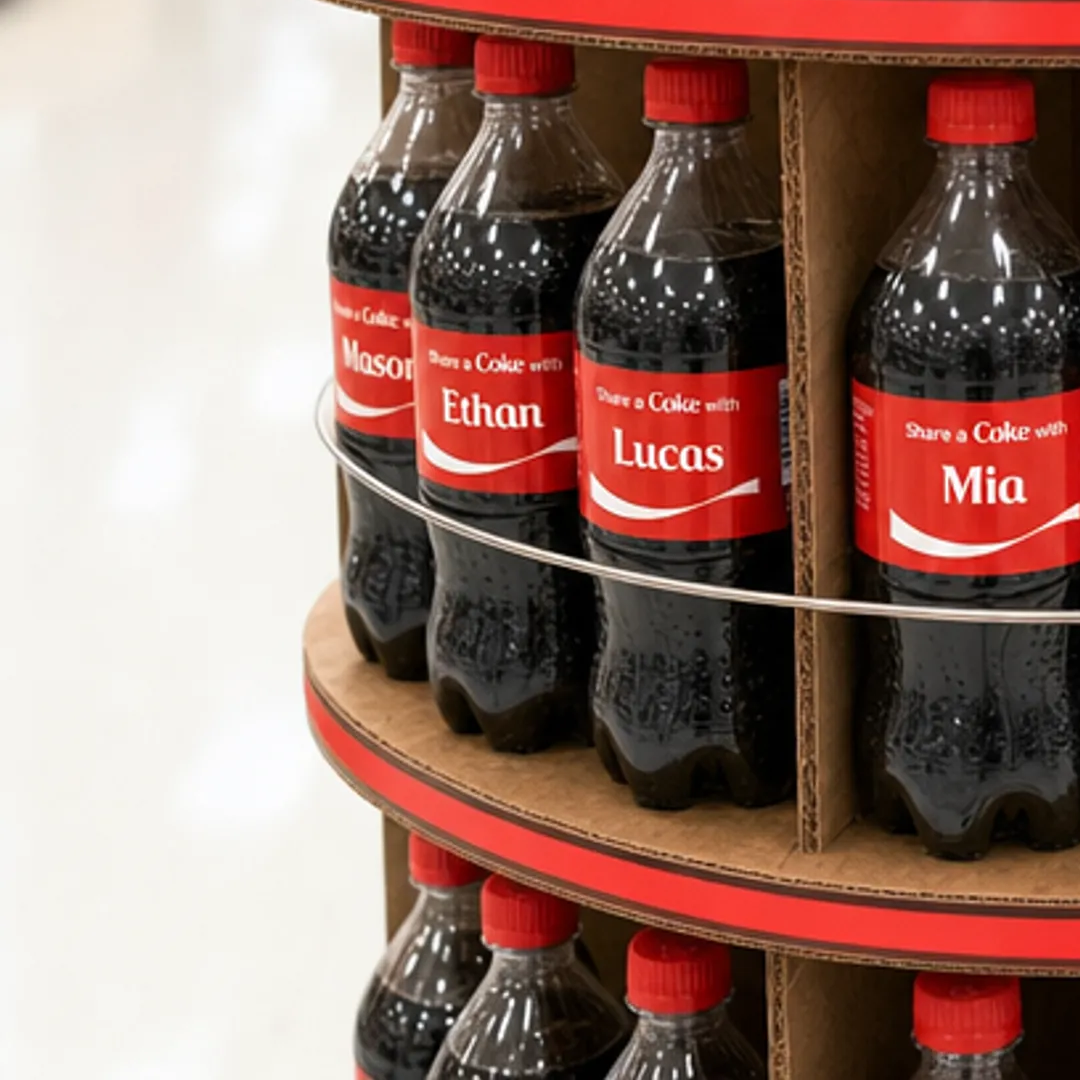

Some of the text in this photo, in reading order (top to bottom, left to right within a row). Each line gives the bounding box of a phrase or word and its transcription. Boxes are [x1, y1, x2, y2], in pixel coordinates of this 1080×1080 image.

[362, 306, 400, 330] Coke
[475, 352, 526, 374] Coke
[442, 386, 544, 429] Ethan
[596, 386, 630, 408] Share
[648, 391, 701, 413] Coke
[905, 421, 951, 442] Share
[973, 421, 1029, 443] Coke
[613, 426, 724, 472] Lucas
[942, 464, 1027, 504] Mia
